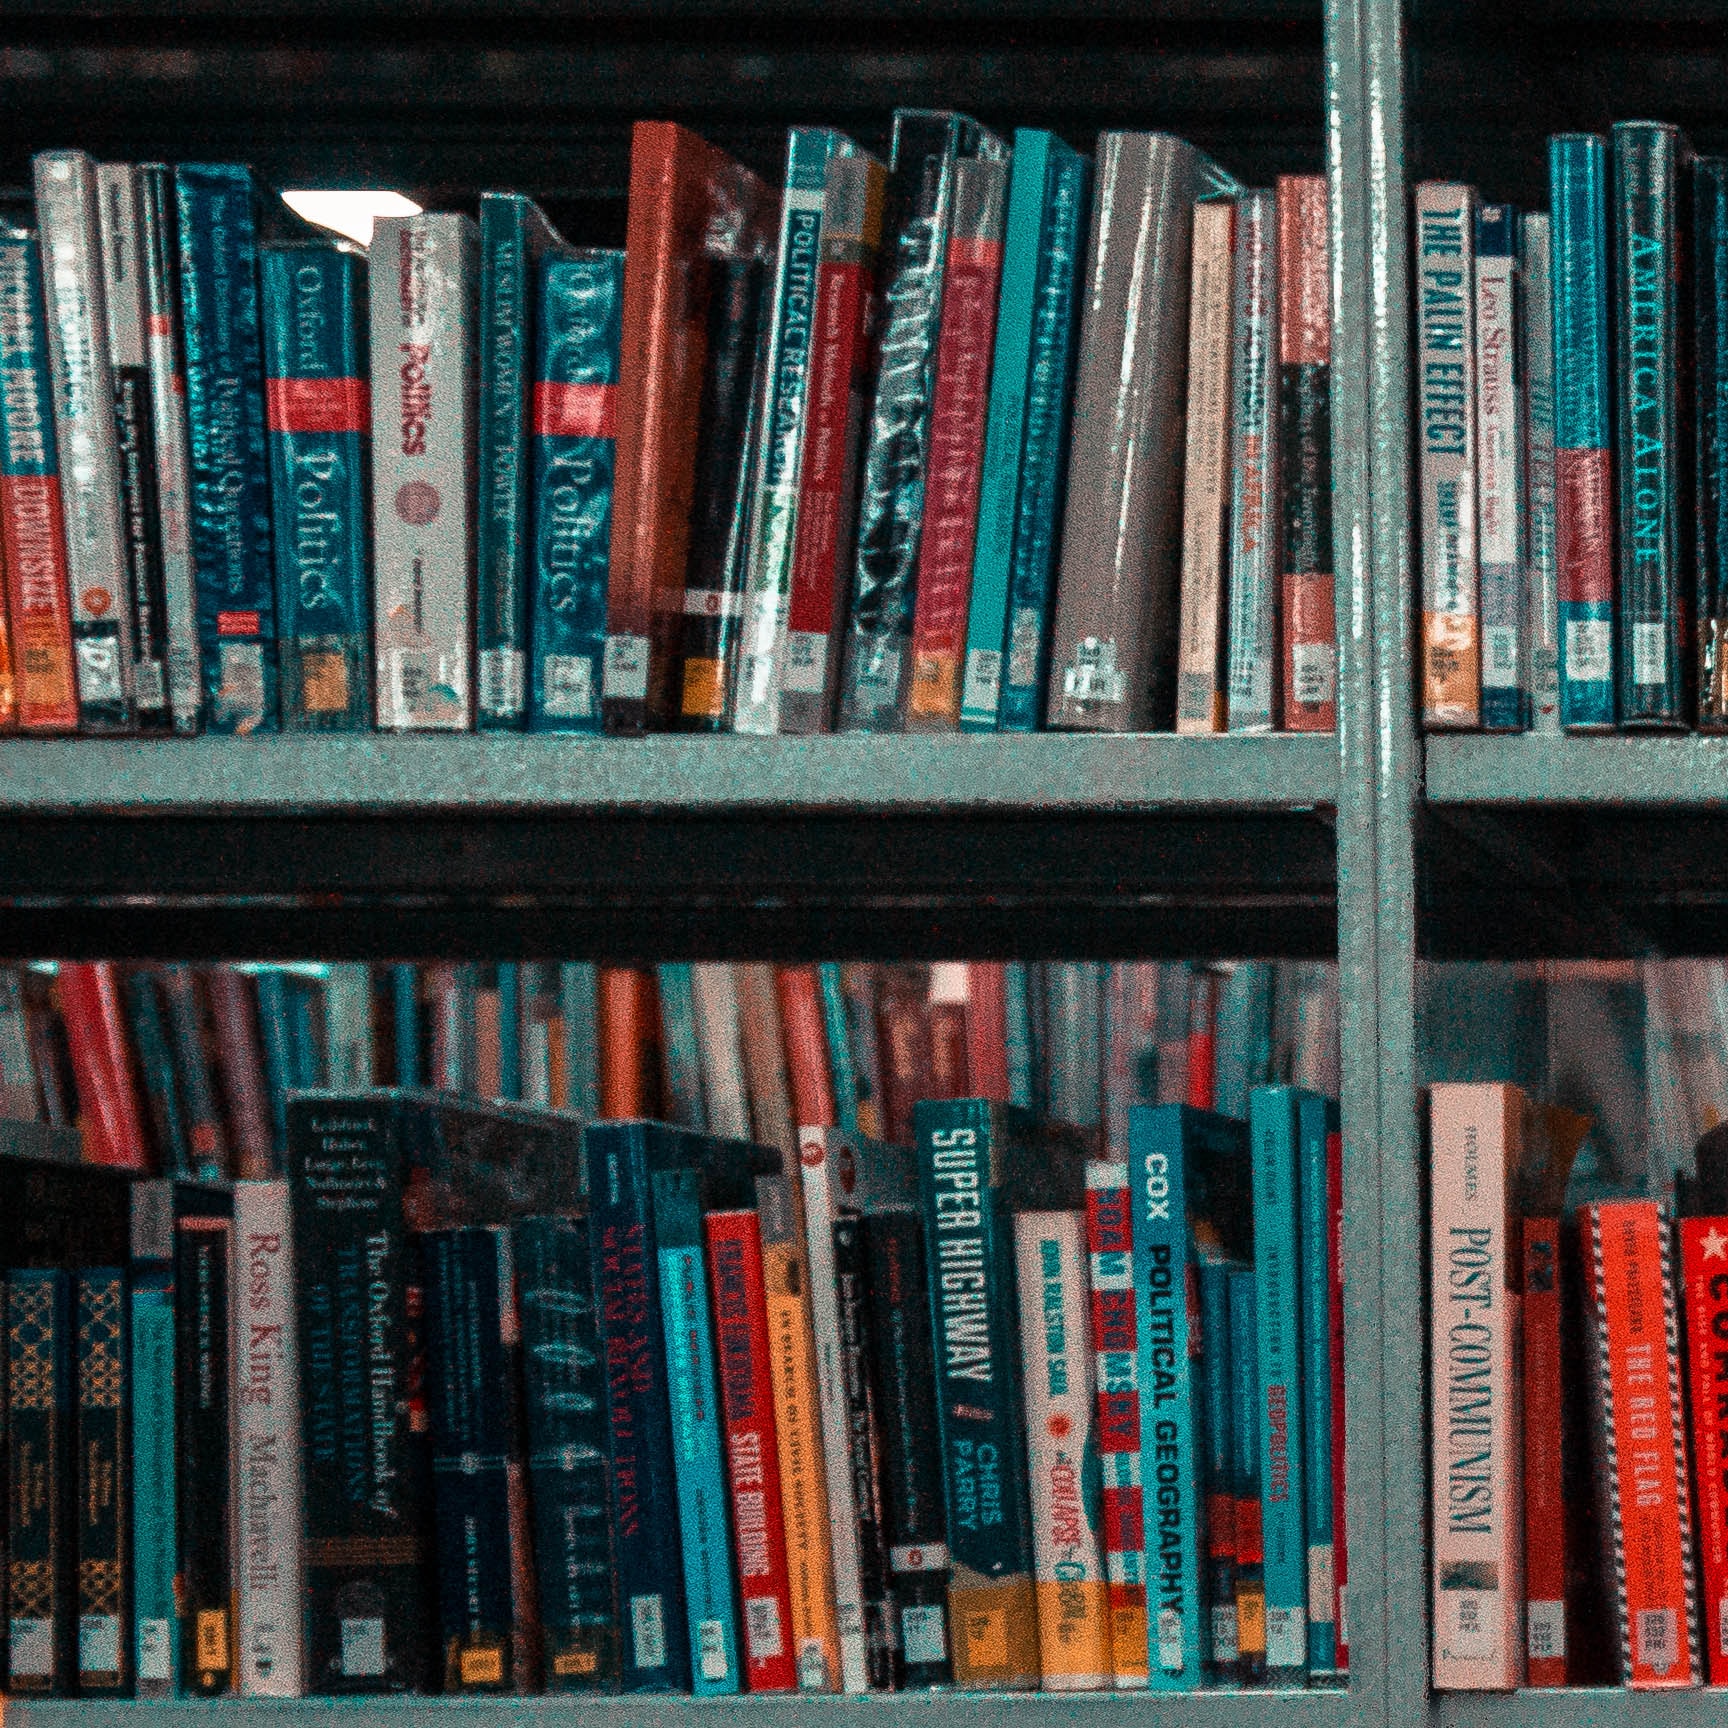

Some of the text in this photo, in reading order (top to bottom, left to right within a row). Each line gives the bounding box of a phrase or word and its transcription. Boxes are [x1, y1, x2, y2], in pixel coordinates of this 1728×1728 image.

[6, 368, 45, 464] MOORE
[400, 342, 430, 455] Politics
[772, 213, 814, 487] POLITICAL RESEARCH
[1423, 208, 1467, 456] THE PALIN EFFECT
[1480, 275, 1506, 416] Leo Strauss
[1632, 233, 1663, 566] AMERICA ALONE
[295, 266, 339, 609] Oxford Politics
[543, 454, 596, 611] Politics
[11, 484, 56, 610] DOWNSIZE
[931, 1128, 993, 1382] SUPER HIGHWAY
[1449, 1126, 1493, 1534] HOLMES POST-COMMUNISM
[243, 1233, 283, 1592] Ross King Machiavelli
[953, 1441, 977, 1530] PARRY
[975, 1442, 1003, 1525] CHRIS
[1146, 1153, 1184, 1614] COX POLITICAL GEOGRAPHY
[1627, 1345, 1661, 1506] THE RED FLAG
